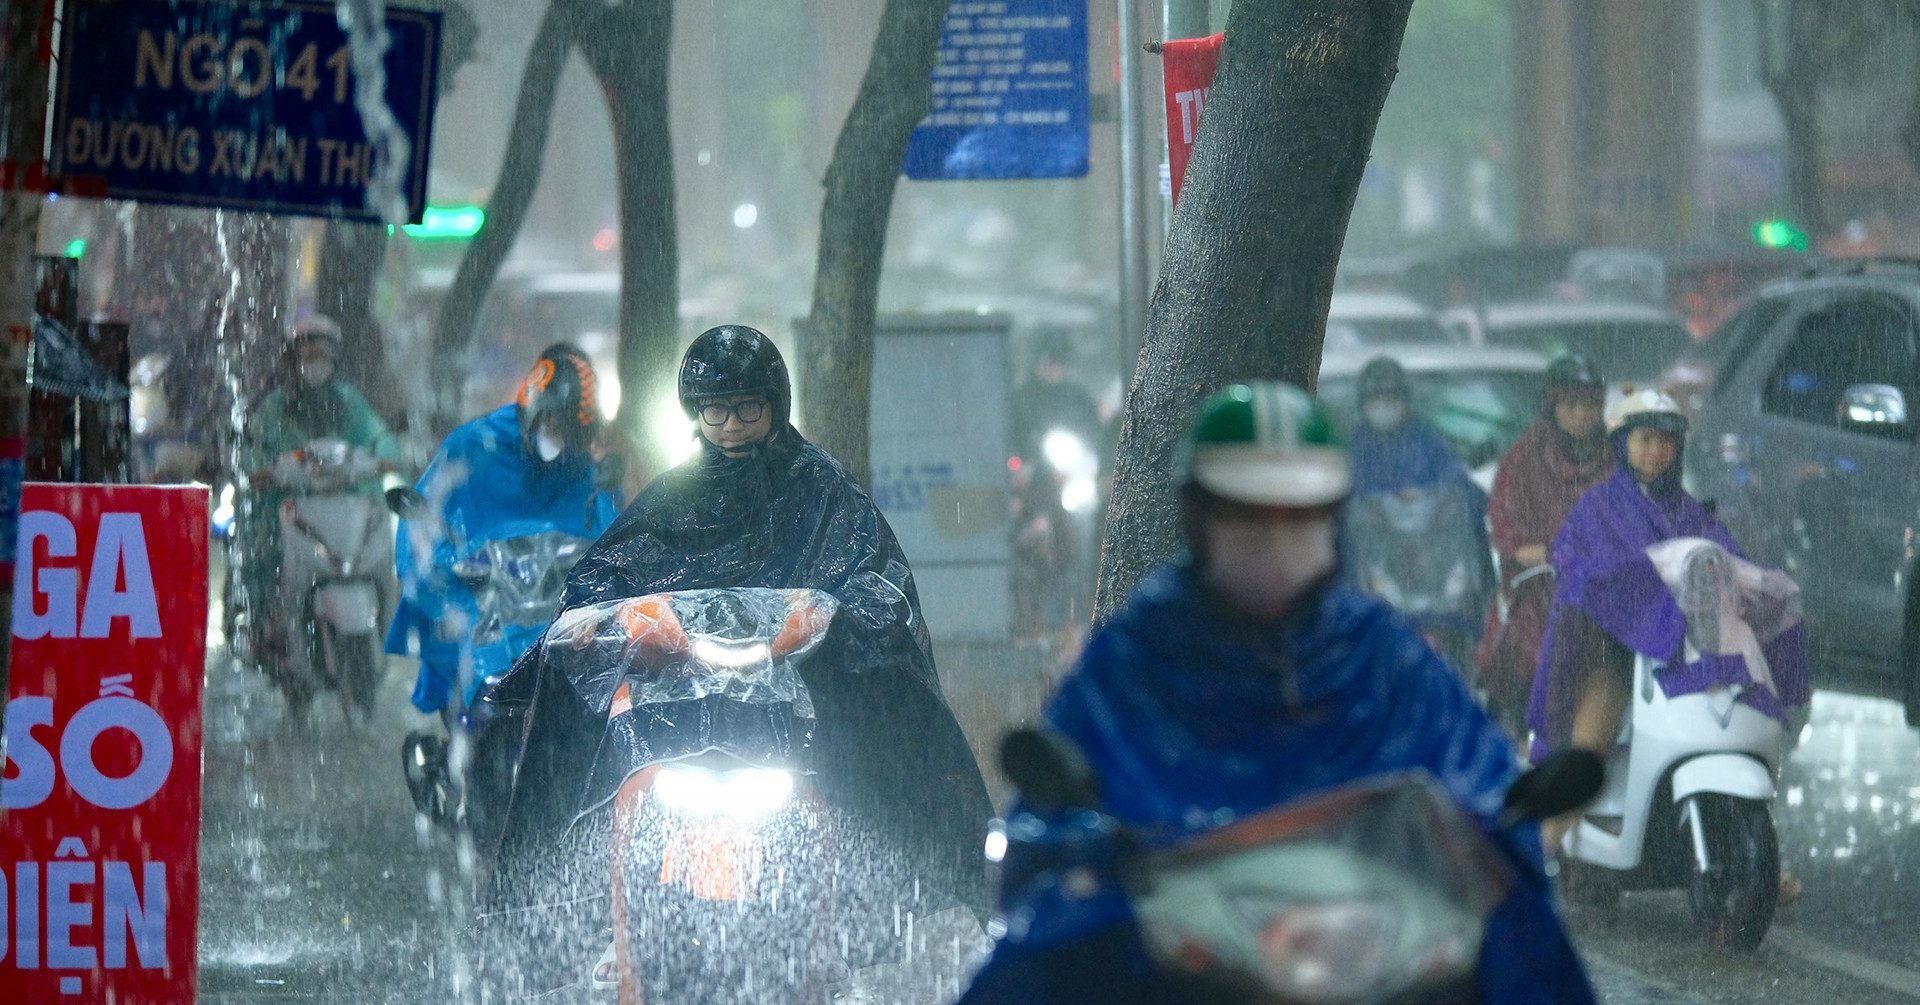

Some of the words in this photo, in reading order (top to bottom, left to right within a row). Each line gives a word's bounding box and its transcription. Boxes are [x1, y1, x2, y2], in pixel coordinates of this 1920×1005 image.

[134, 18, 272, 99] NGÕ
[285, 41, 350, 104] 41
[12, 509, 163, 641] GA
[1, 672, 174, 811] SỐ
[0, 836, 167, 995] IỆN
